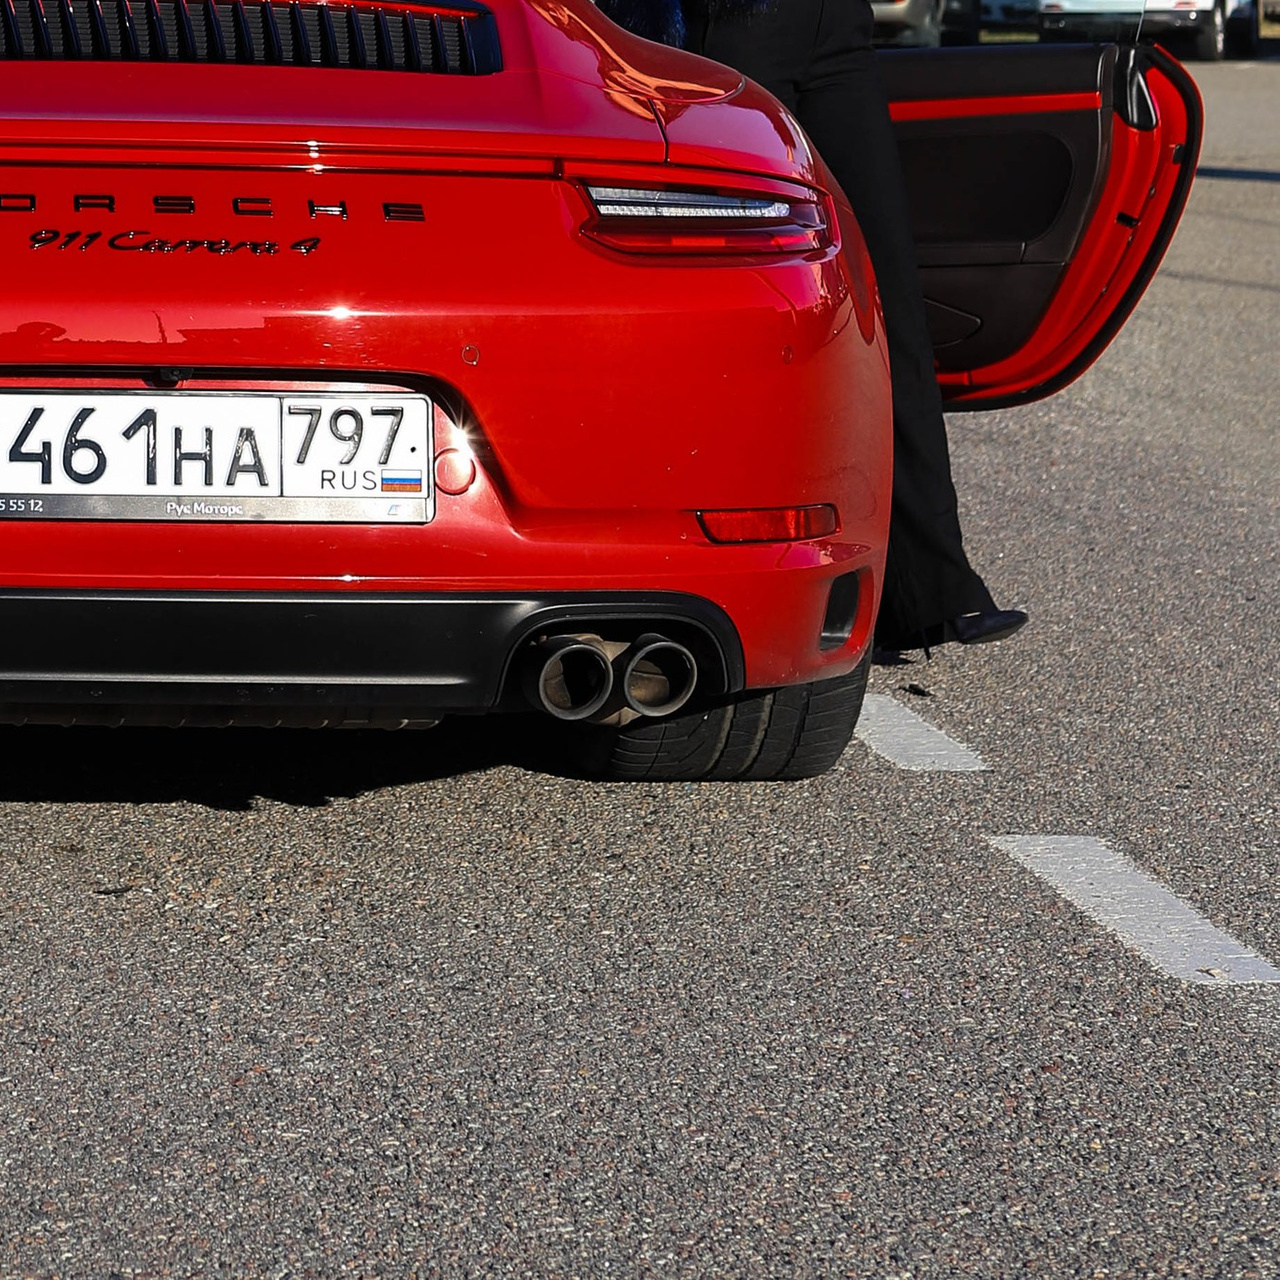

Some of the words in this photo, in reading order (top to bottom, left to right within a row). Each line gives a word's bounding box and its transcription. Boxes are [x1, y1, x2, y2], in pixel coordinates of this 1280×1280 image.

[29, 230, 103, 251] 911
[107, 231, 280, 255] Carrera
[290, 238, 321, 255] 4
[288, 405, 404, 465] 797
[321, 469, 377, 491] RUS
[9, 498, 25, 512] 55
[27, 498, 44, 513] 12
[166, 501, 191, 517] Рус
[193, 501, 244, 517] Моторс
